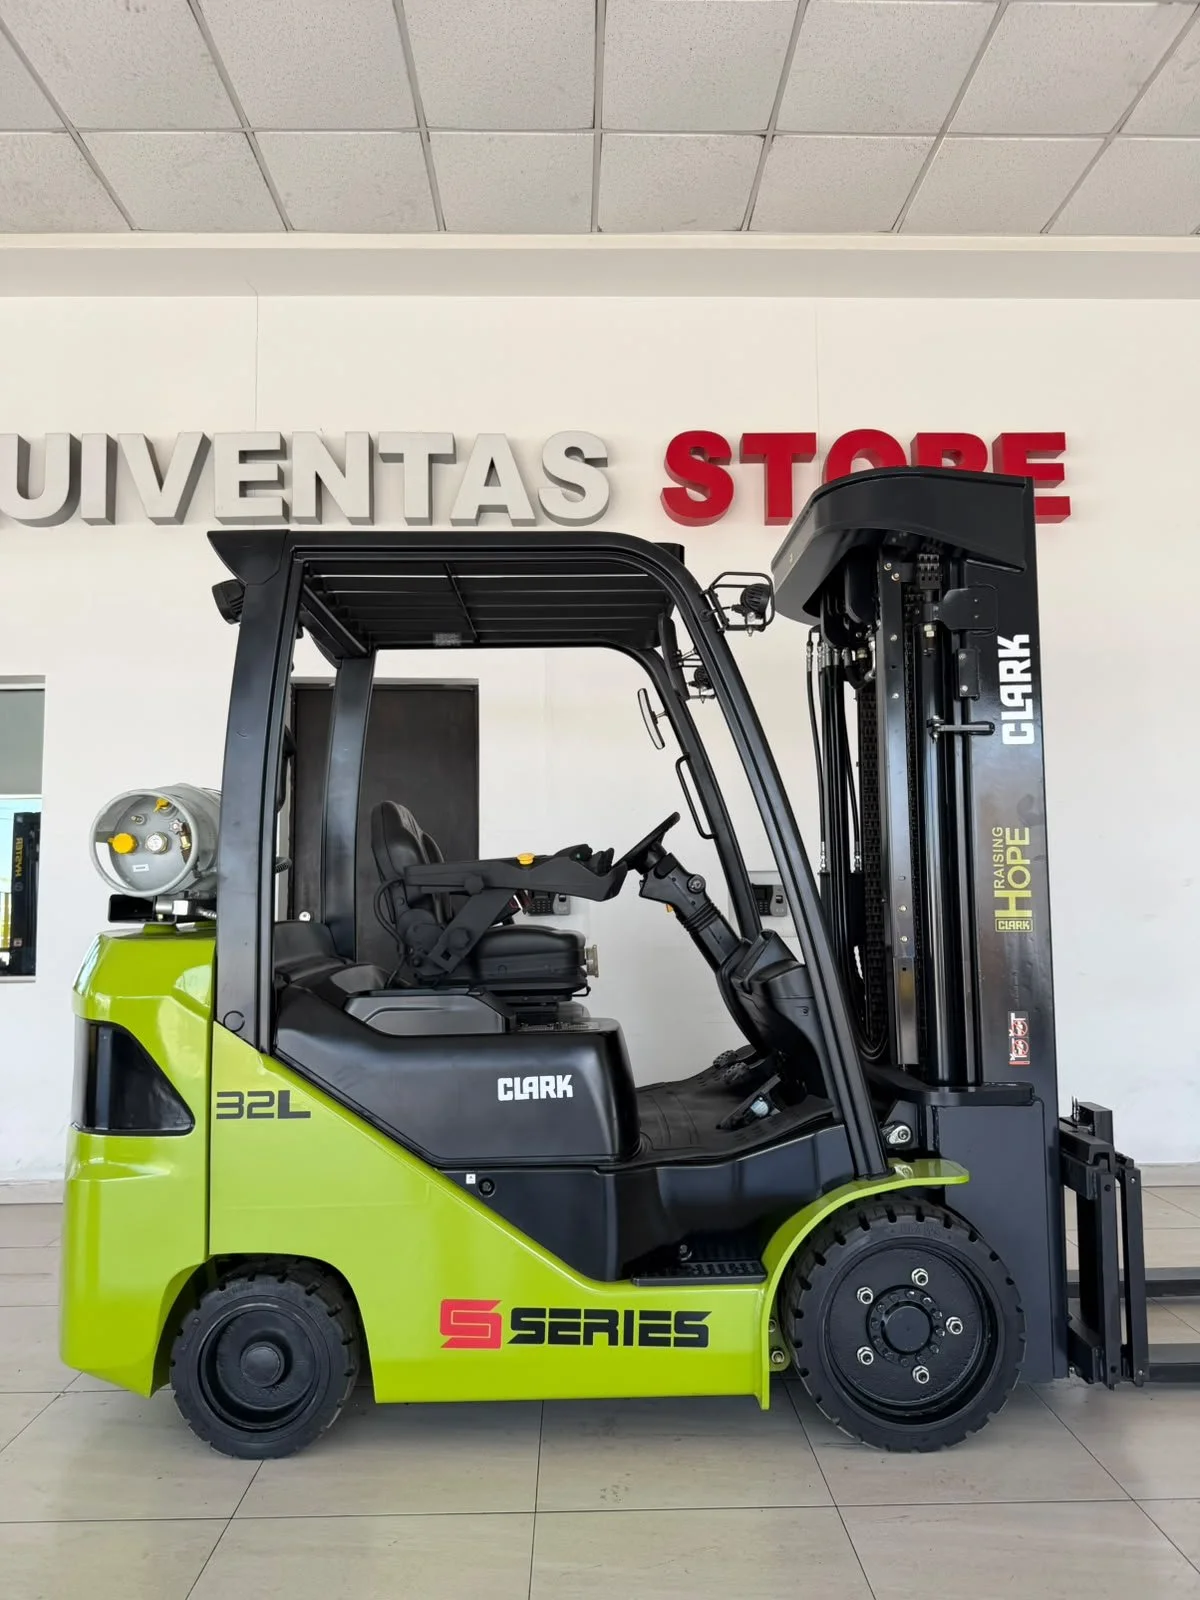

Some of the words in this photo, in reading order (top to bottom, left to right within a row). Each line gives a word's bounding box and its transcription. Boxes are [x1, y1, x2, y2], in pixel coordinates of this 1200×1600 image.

[0, 430, 610, 528] UIVENTAS
[997, 634, 1035, 745] CLARK
[992, 826, 1005, 889] RAISING
[994, 827, 1033, 918] HOPE
[997, 919, 1030, 931] CLARK
[216, 1090, 311, 1120] 32L
[497, 1074, 574, 1101] CLARK
[506, 1307, 713, 1349] SERIES
